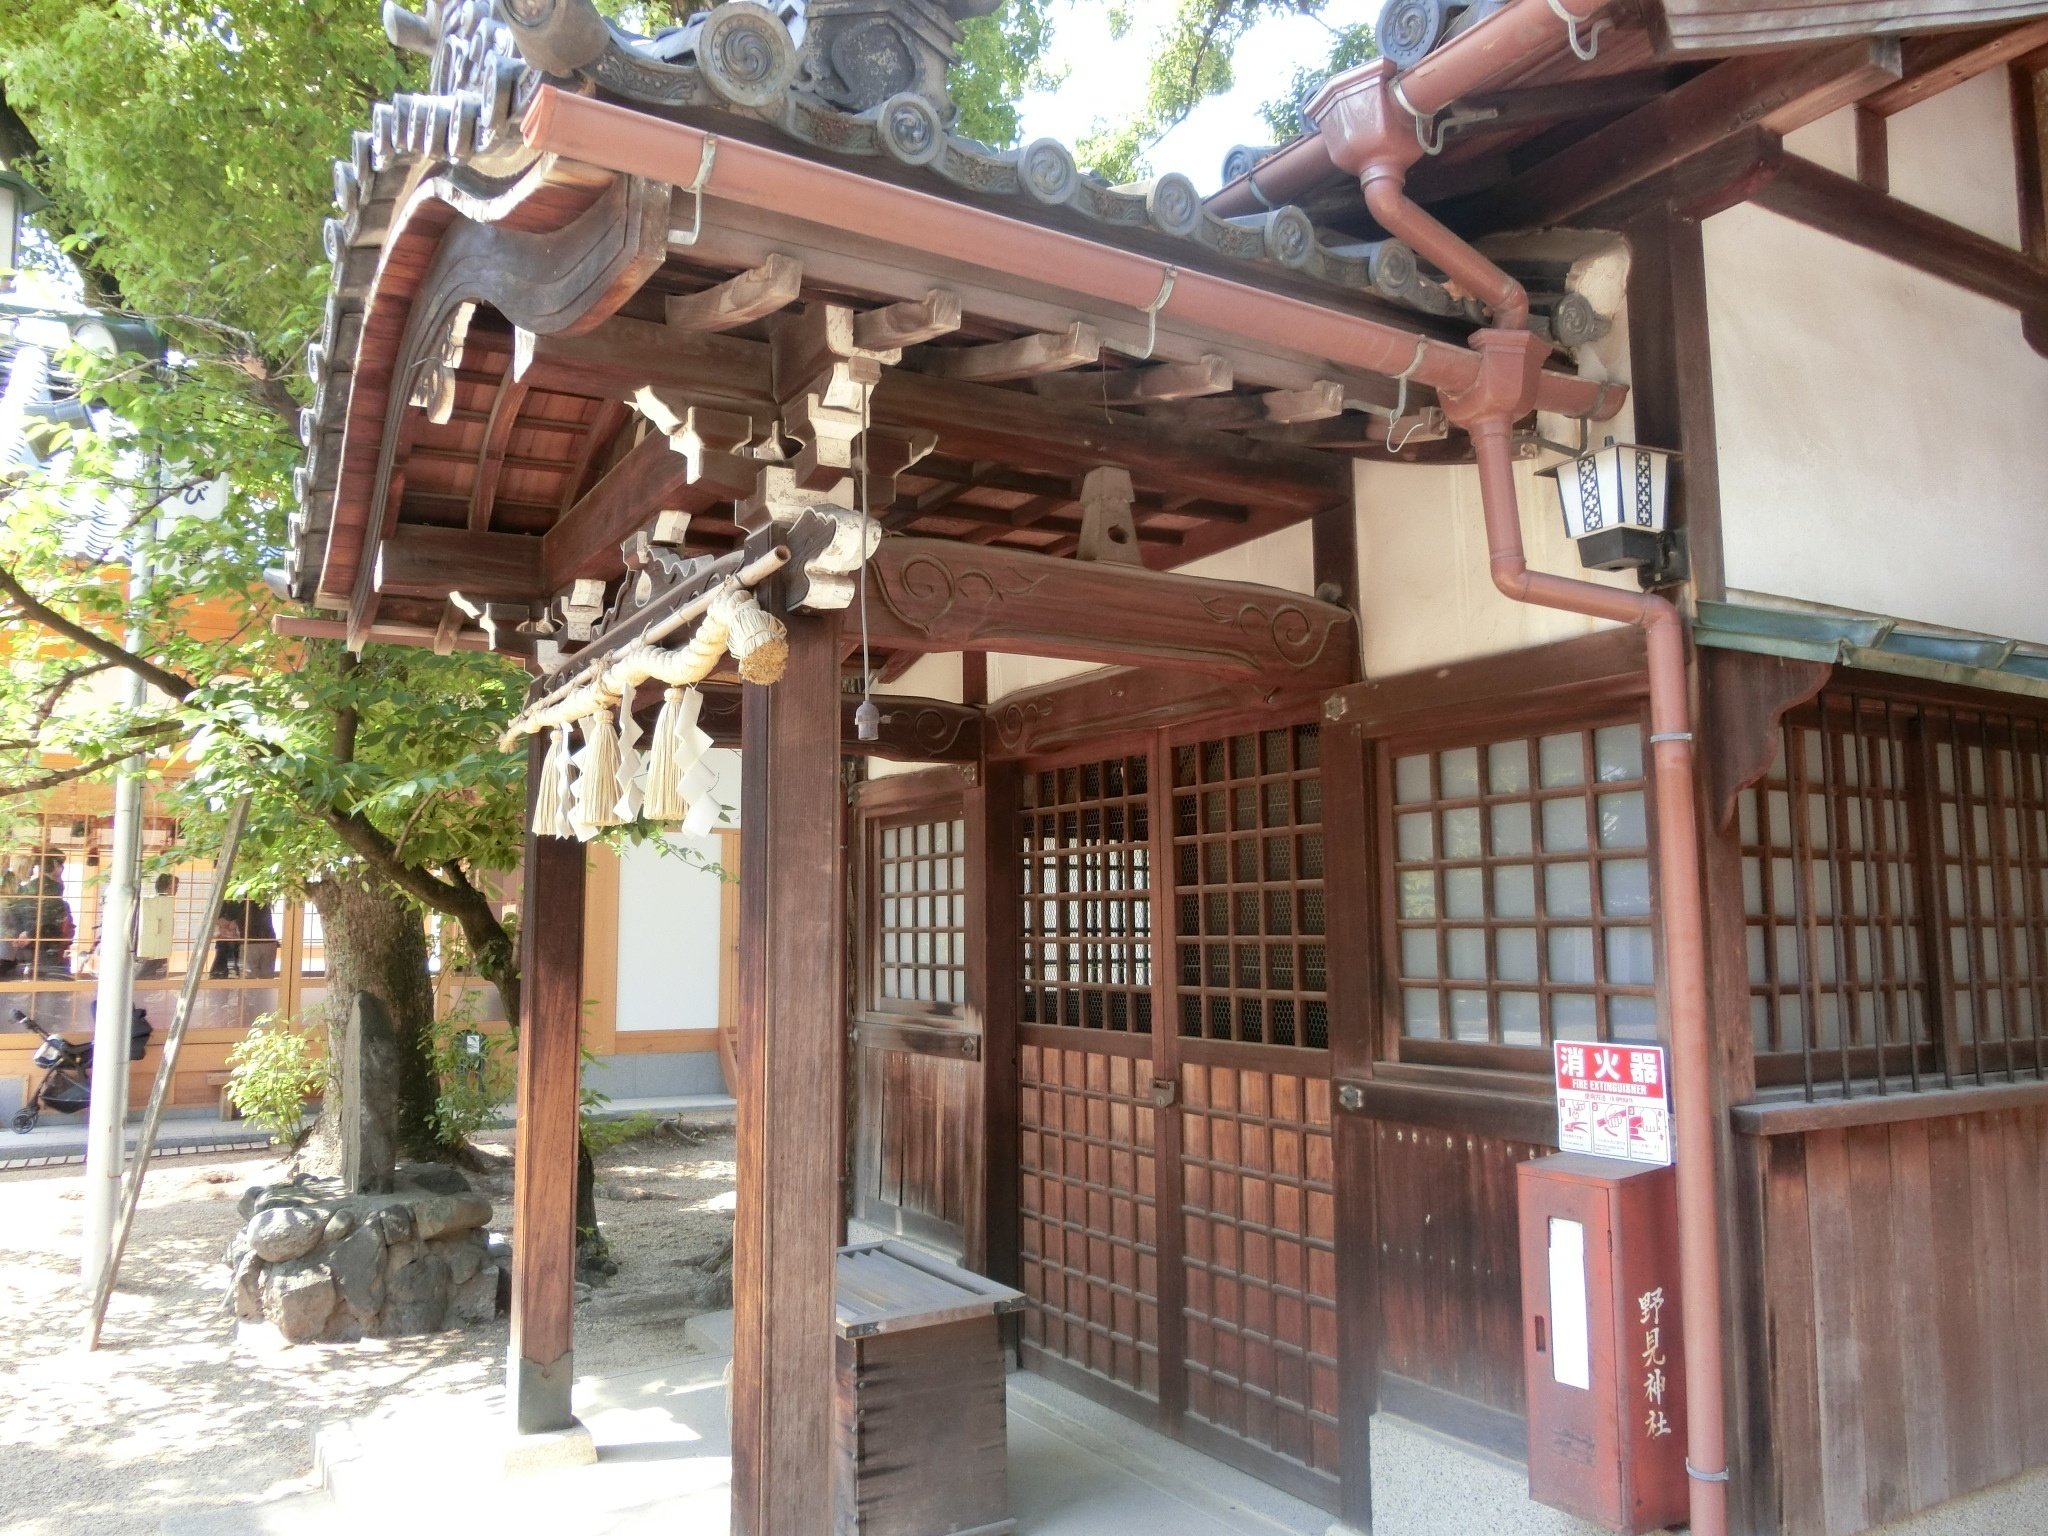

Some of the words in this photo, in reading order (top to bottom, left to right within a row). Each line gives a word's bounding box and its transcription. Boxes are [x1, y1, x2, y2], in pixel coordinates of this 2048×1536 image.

[1560, 1046, 1657, 1084] 消火器
[1572, 1079, 1588, 1090] FIRE
[1638, 1287, 1671, 1440] 野見神社
